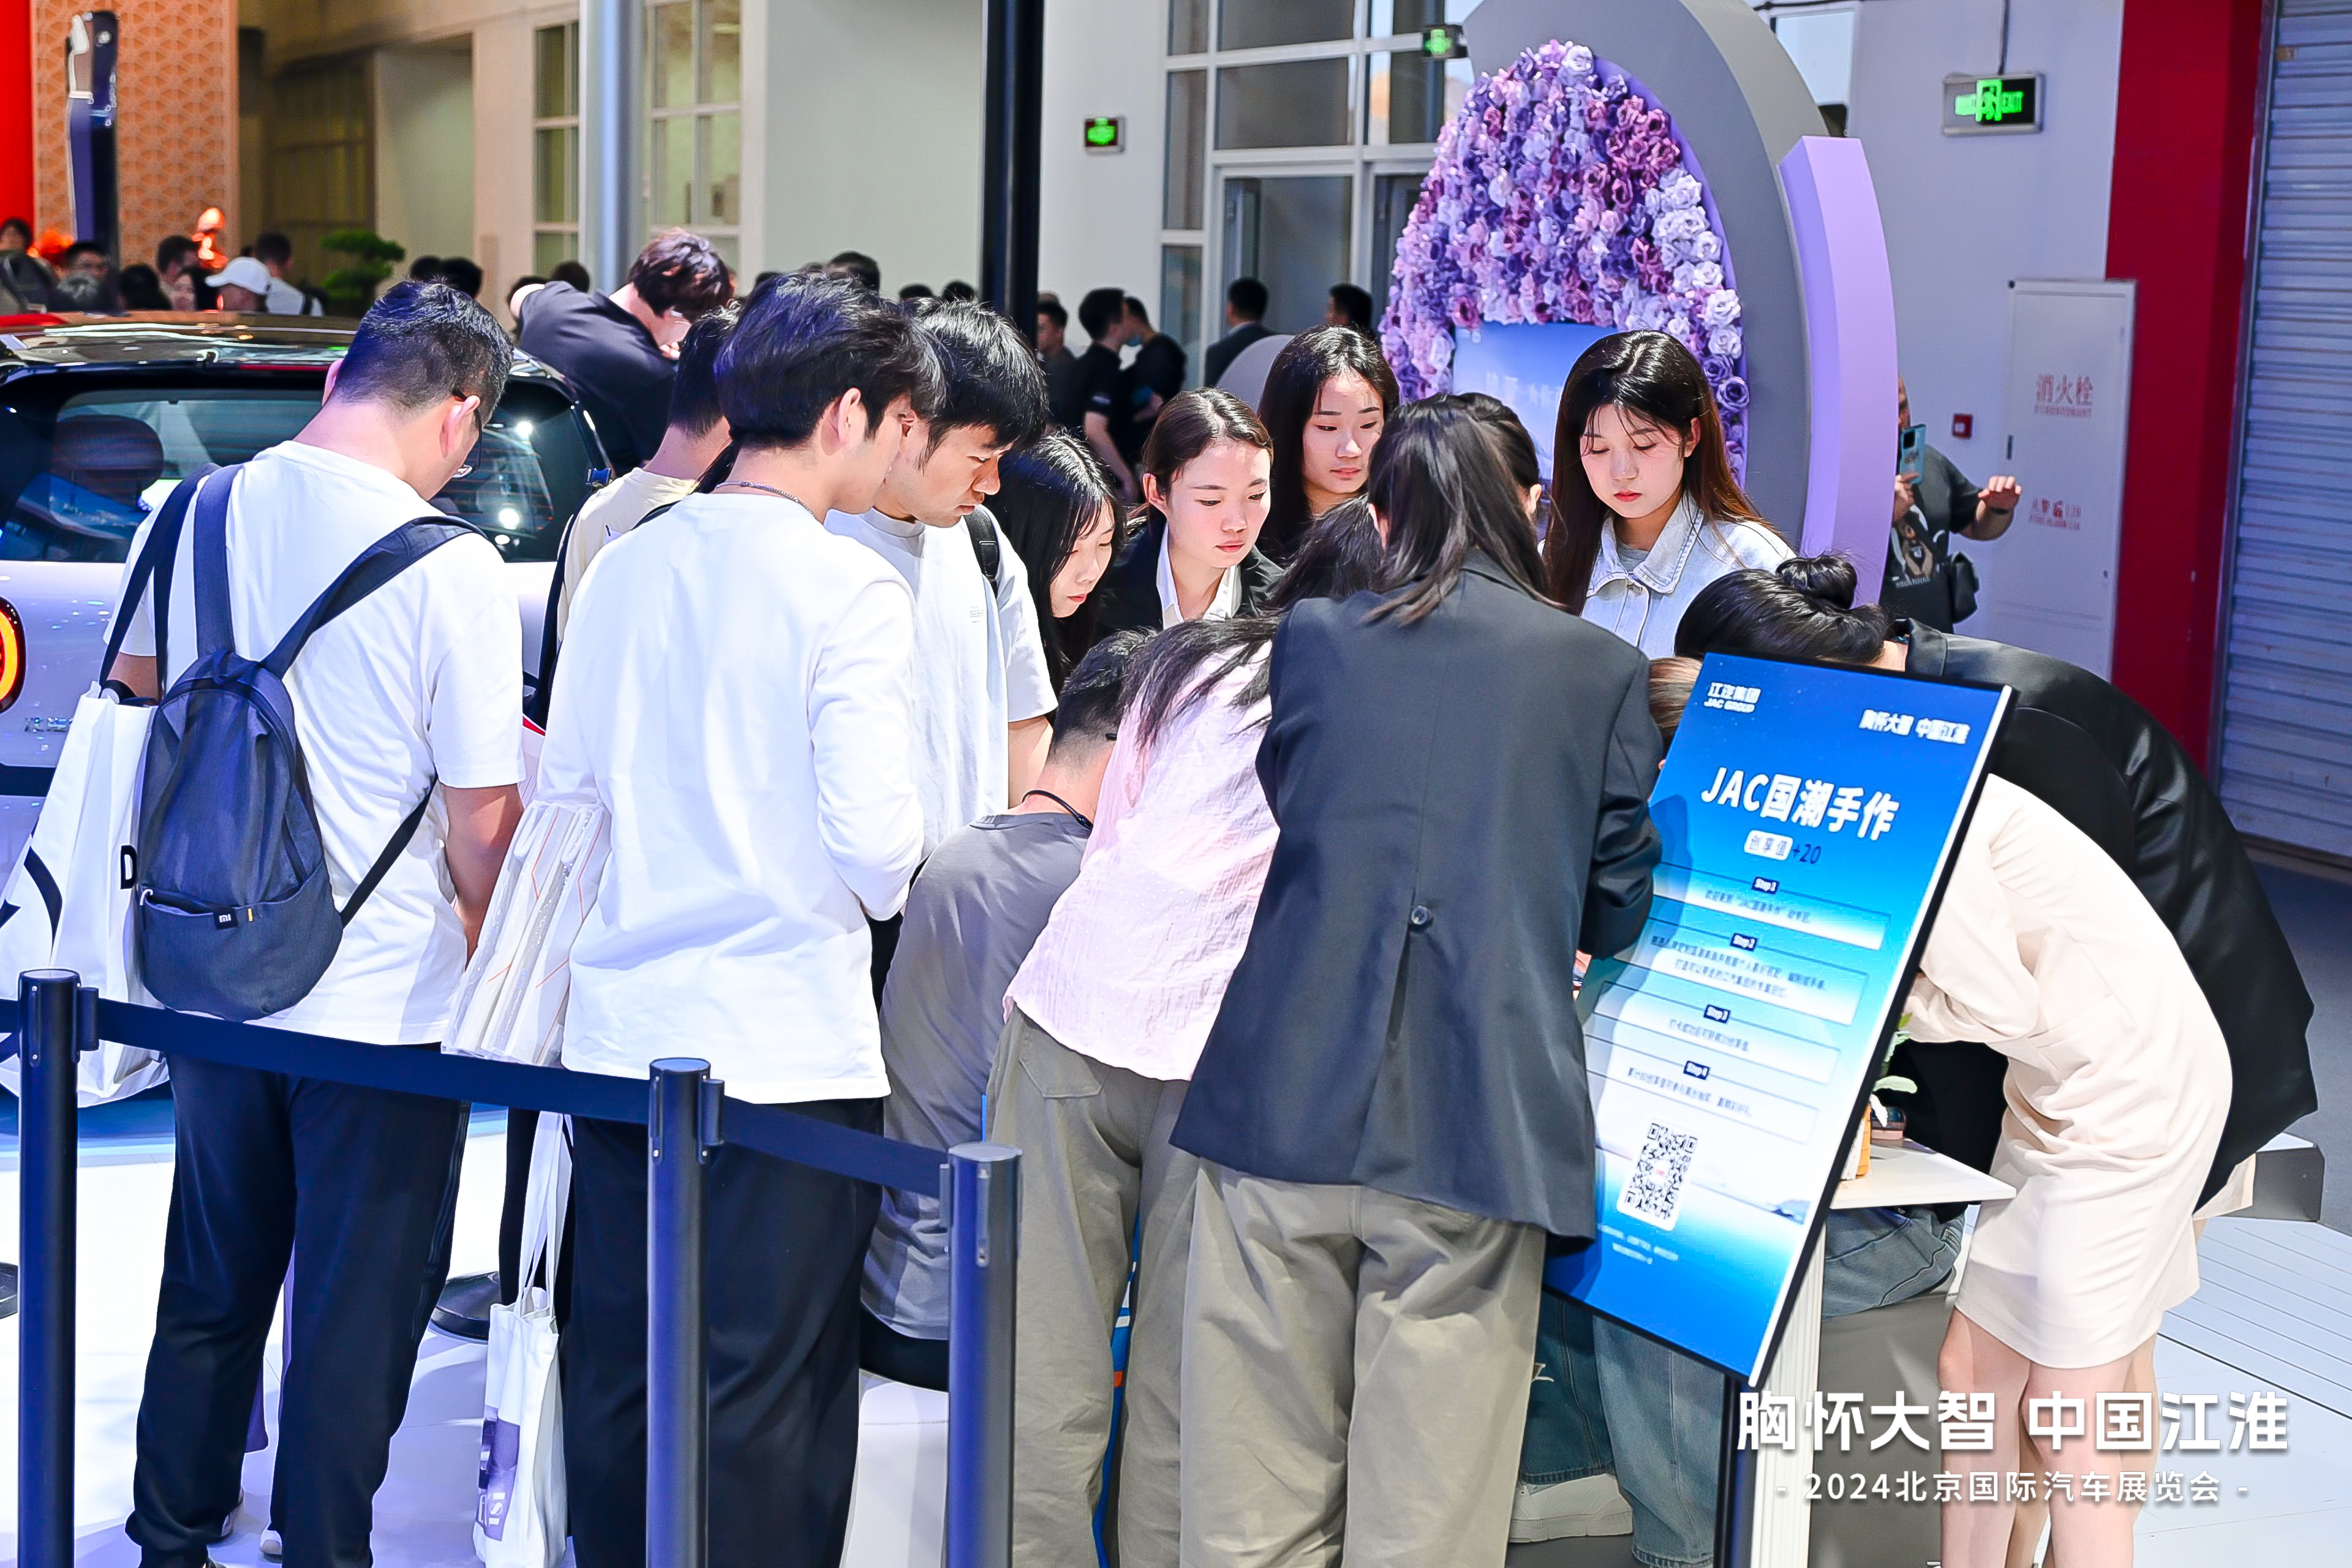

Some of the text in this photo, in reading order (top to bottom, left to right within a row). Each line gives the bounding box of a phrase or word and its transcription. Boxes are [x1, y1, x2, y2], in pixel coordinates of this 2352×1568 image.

[2035, 374, 2094, 405] 消火栓
[1701, 767, 1899, 841] JAC国潮手作
